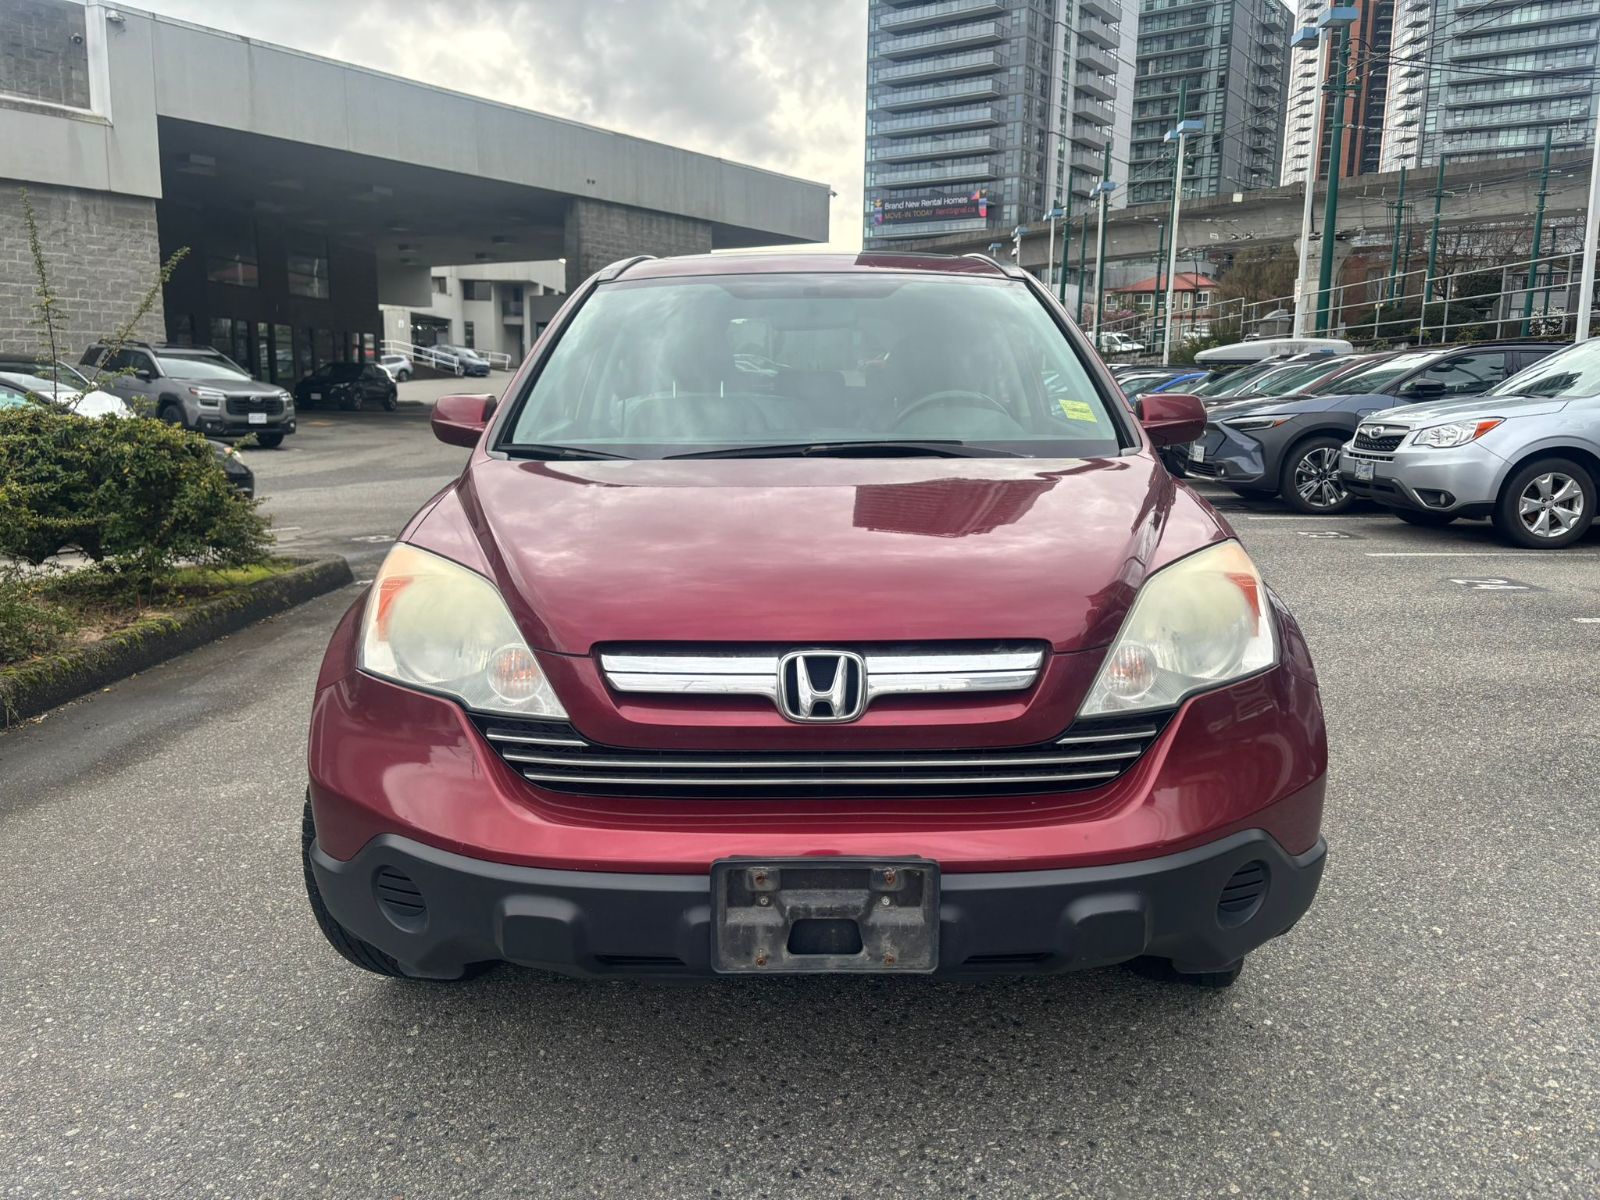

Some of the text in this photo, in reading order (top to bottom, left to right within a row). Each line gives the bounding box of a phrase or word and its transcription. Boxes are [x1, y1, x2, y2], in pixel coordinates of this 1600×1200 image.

[884, 196, 968, 210] Brand New Rental Homes
[913, 210, 933, 218] TODAY
